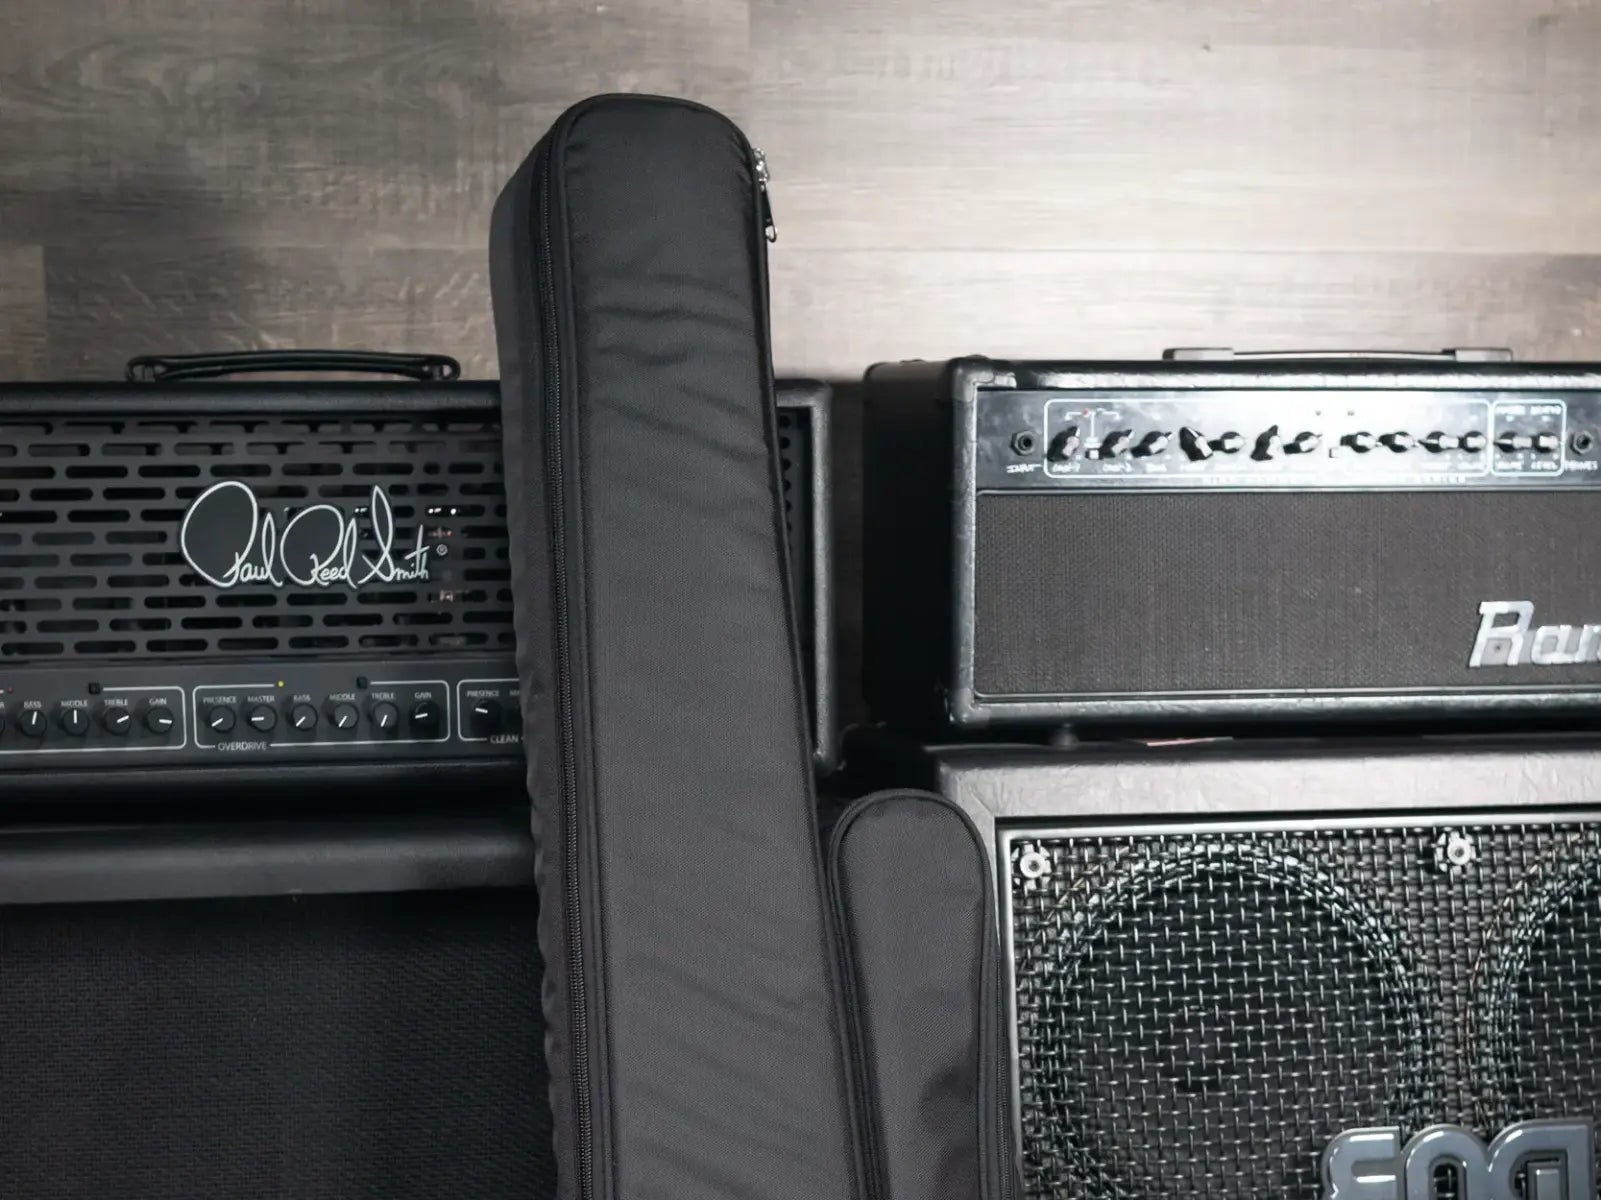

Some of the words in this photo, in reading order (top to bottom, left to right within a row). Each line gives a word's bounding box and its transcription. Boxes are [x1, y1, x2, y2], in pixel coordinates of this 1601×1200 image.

[181, 480, 283, 588] Paul
[280, 504, 358, 590] Reed
[357, 485, 430, 586] Smith
[202, 696, 237, 705] PRESENCE
[247, 695, 275, 704] MASTER
[371, 691, 395, 700] TREBLE
[414, 691, 432, 700] GAIN
[466, 689, 500, 698] PRESENCE
[103, 698, 129, 707] TREBLE
[149, 697, 167, 706] GAIN
[489, 734, 519, 745] CLEAN
[217, 741, 267, 752] OVERDRIVE
